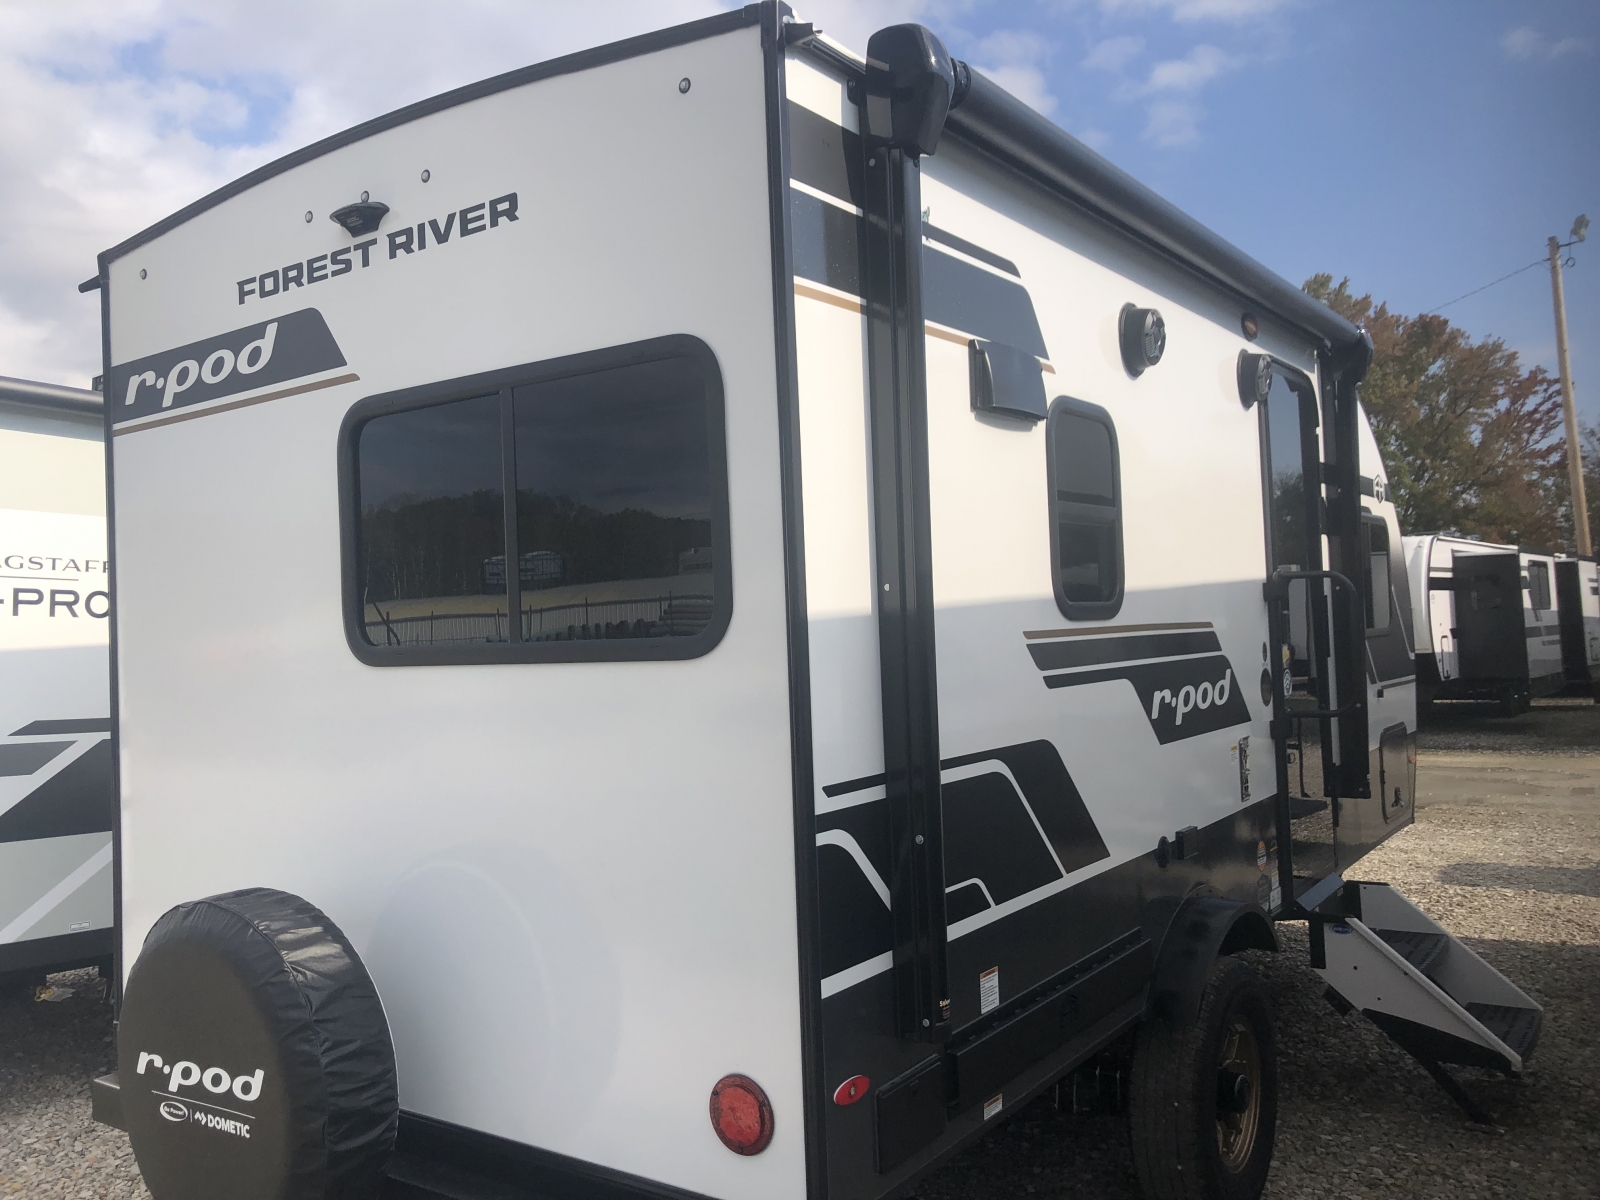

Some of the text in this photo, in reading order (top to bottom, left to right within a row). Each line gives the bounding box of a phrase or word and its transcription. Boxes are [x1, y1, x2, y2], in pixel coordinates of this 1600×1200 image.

[236, 191, 520, 306] FOREST RIVER
[207, 1113, 251, 1139] DOMETIC
